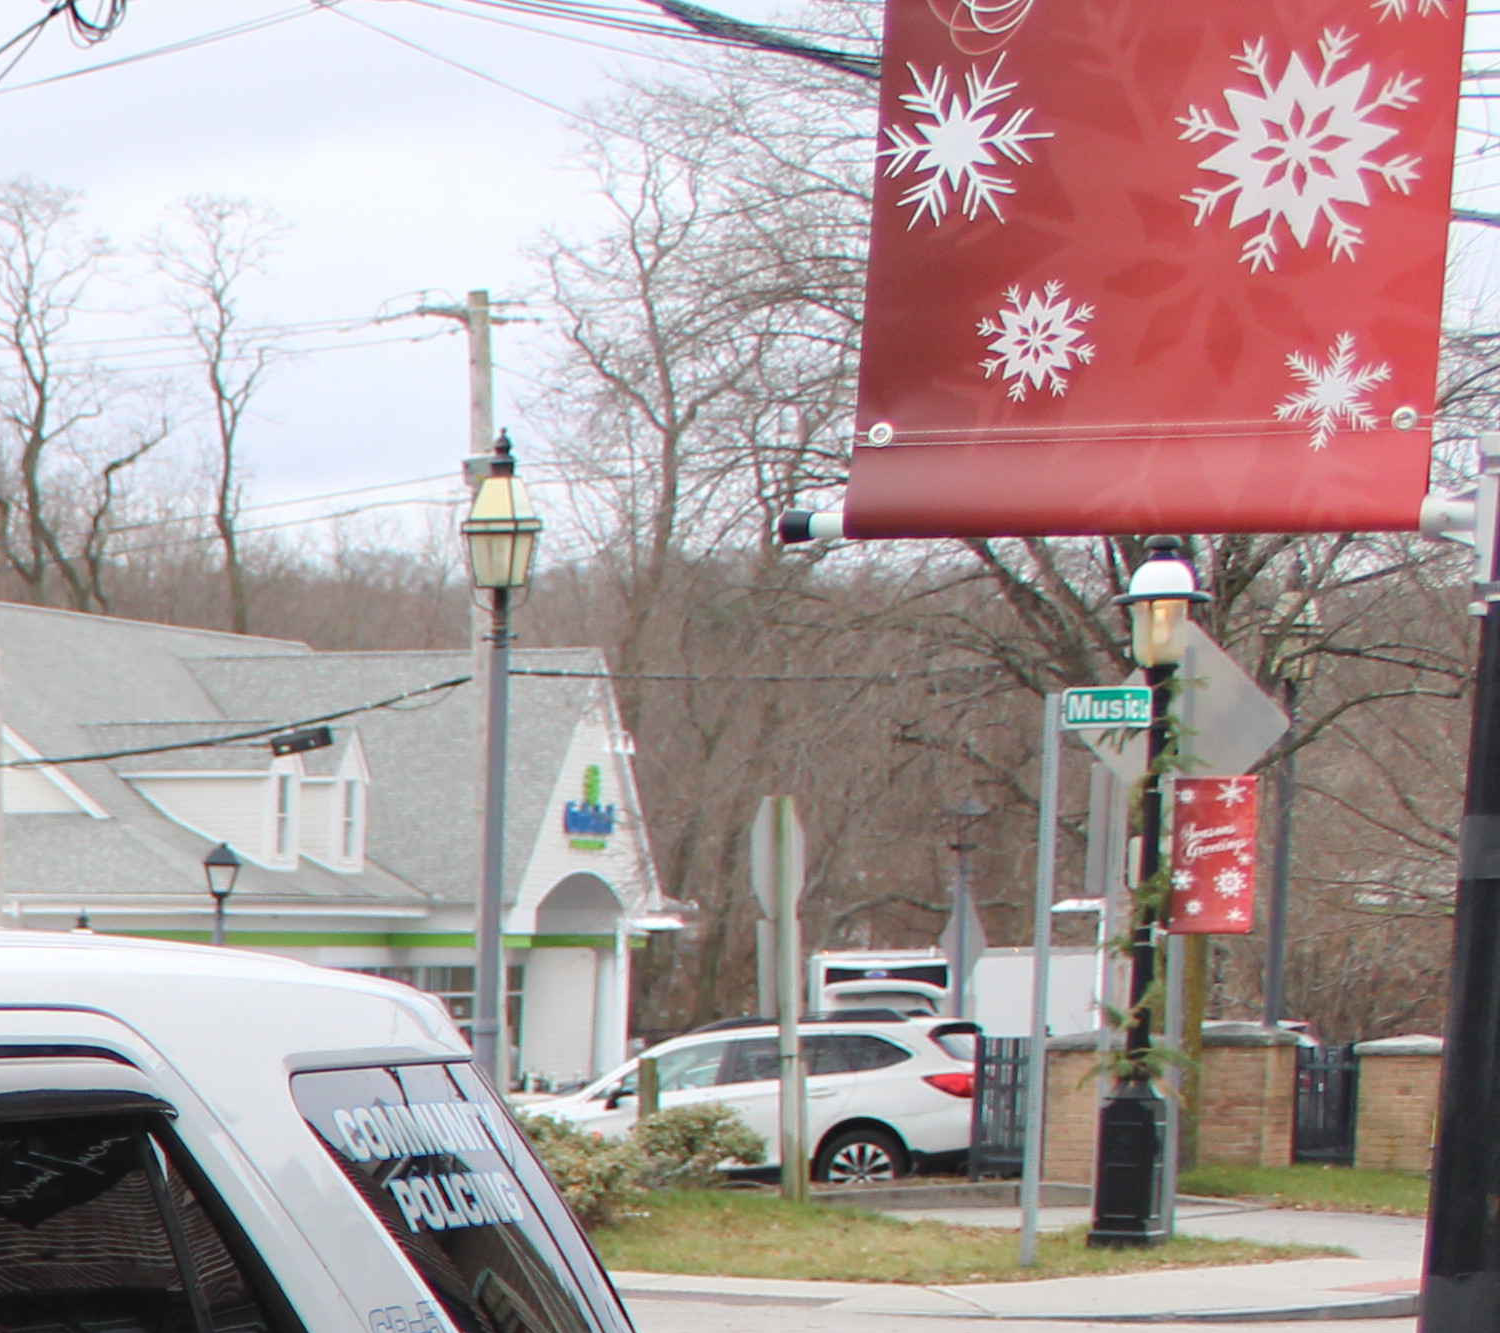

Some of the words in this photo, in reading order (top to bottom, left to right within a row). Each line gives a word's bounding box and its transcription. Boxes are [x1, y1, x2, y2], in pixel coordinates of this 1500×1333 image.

[1067, 693, 1138, 719] Music
[333, 1102, 507, 1163] COMMUNITY
[389, 1171, 524, 1235] POLICING
